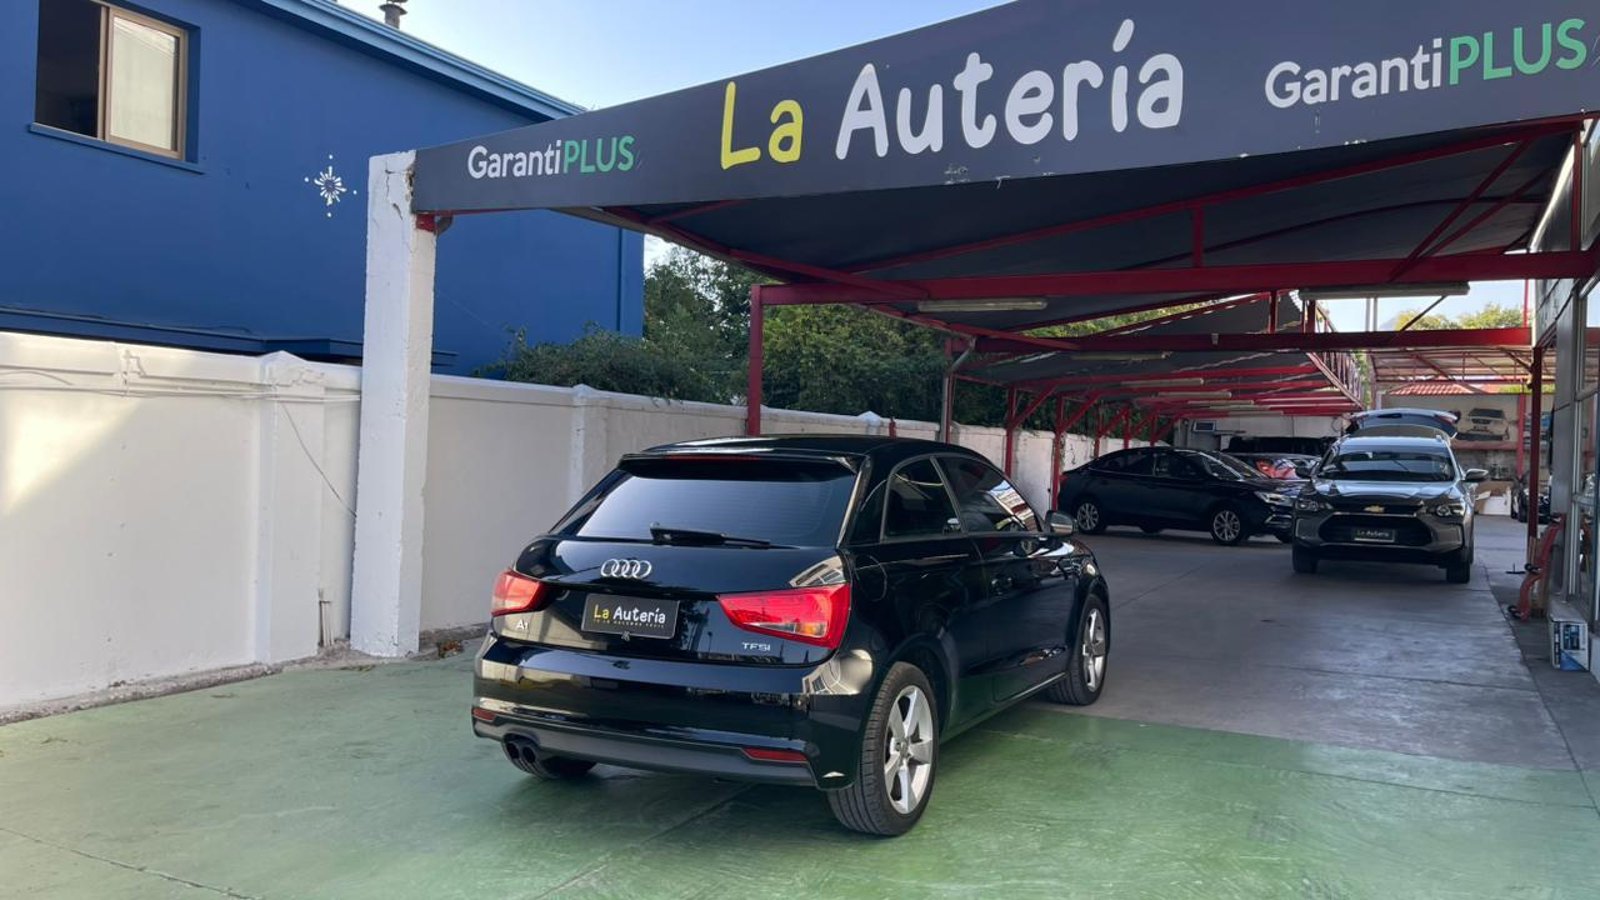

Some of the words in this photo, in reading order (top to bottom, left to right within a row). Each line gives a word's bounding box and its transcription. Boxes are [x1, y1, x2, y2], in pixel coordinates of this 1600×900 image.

[1265, 18, 1587, 108] GarantiPLUS
[721, 81, 803, 170] La
[835, 18, 1184, 160] Autería
[467, 135, 635, 179] GarantiPLUS
[593, 604, 609, 619] La
[613, 606, 666, 624] Autería
[741, 641, 770, 651] TFSI
